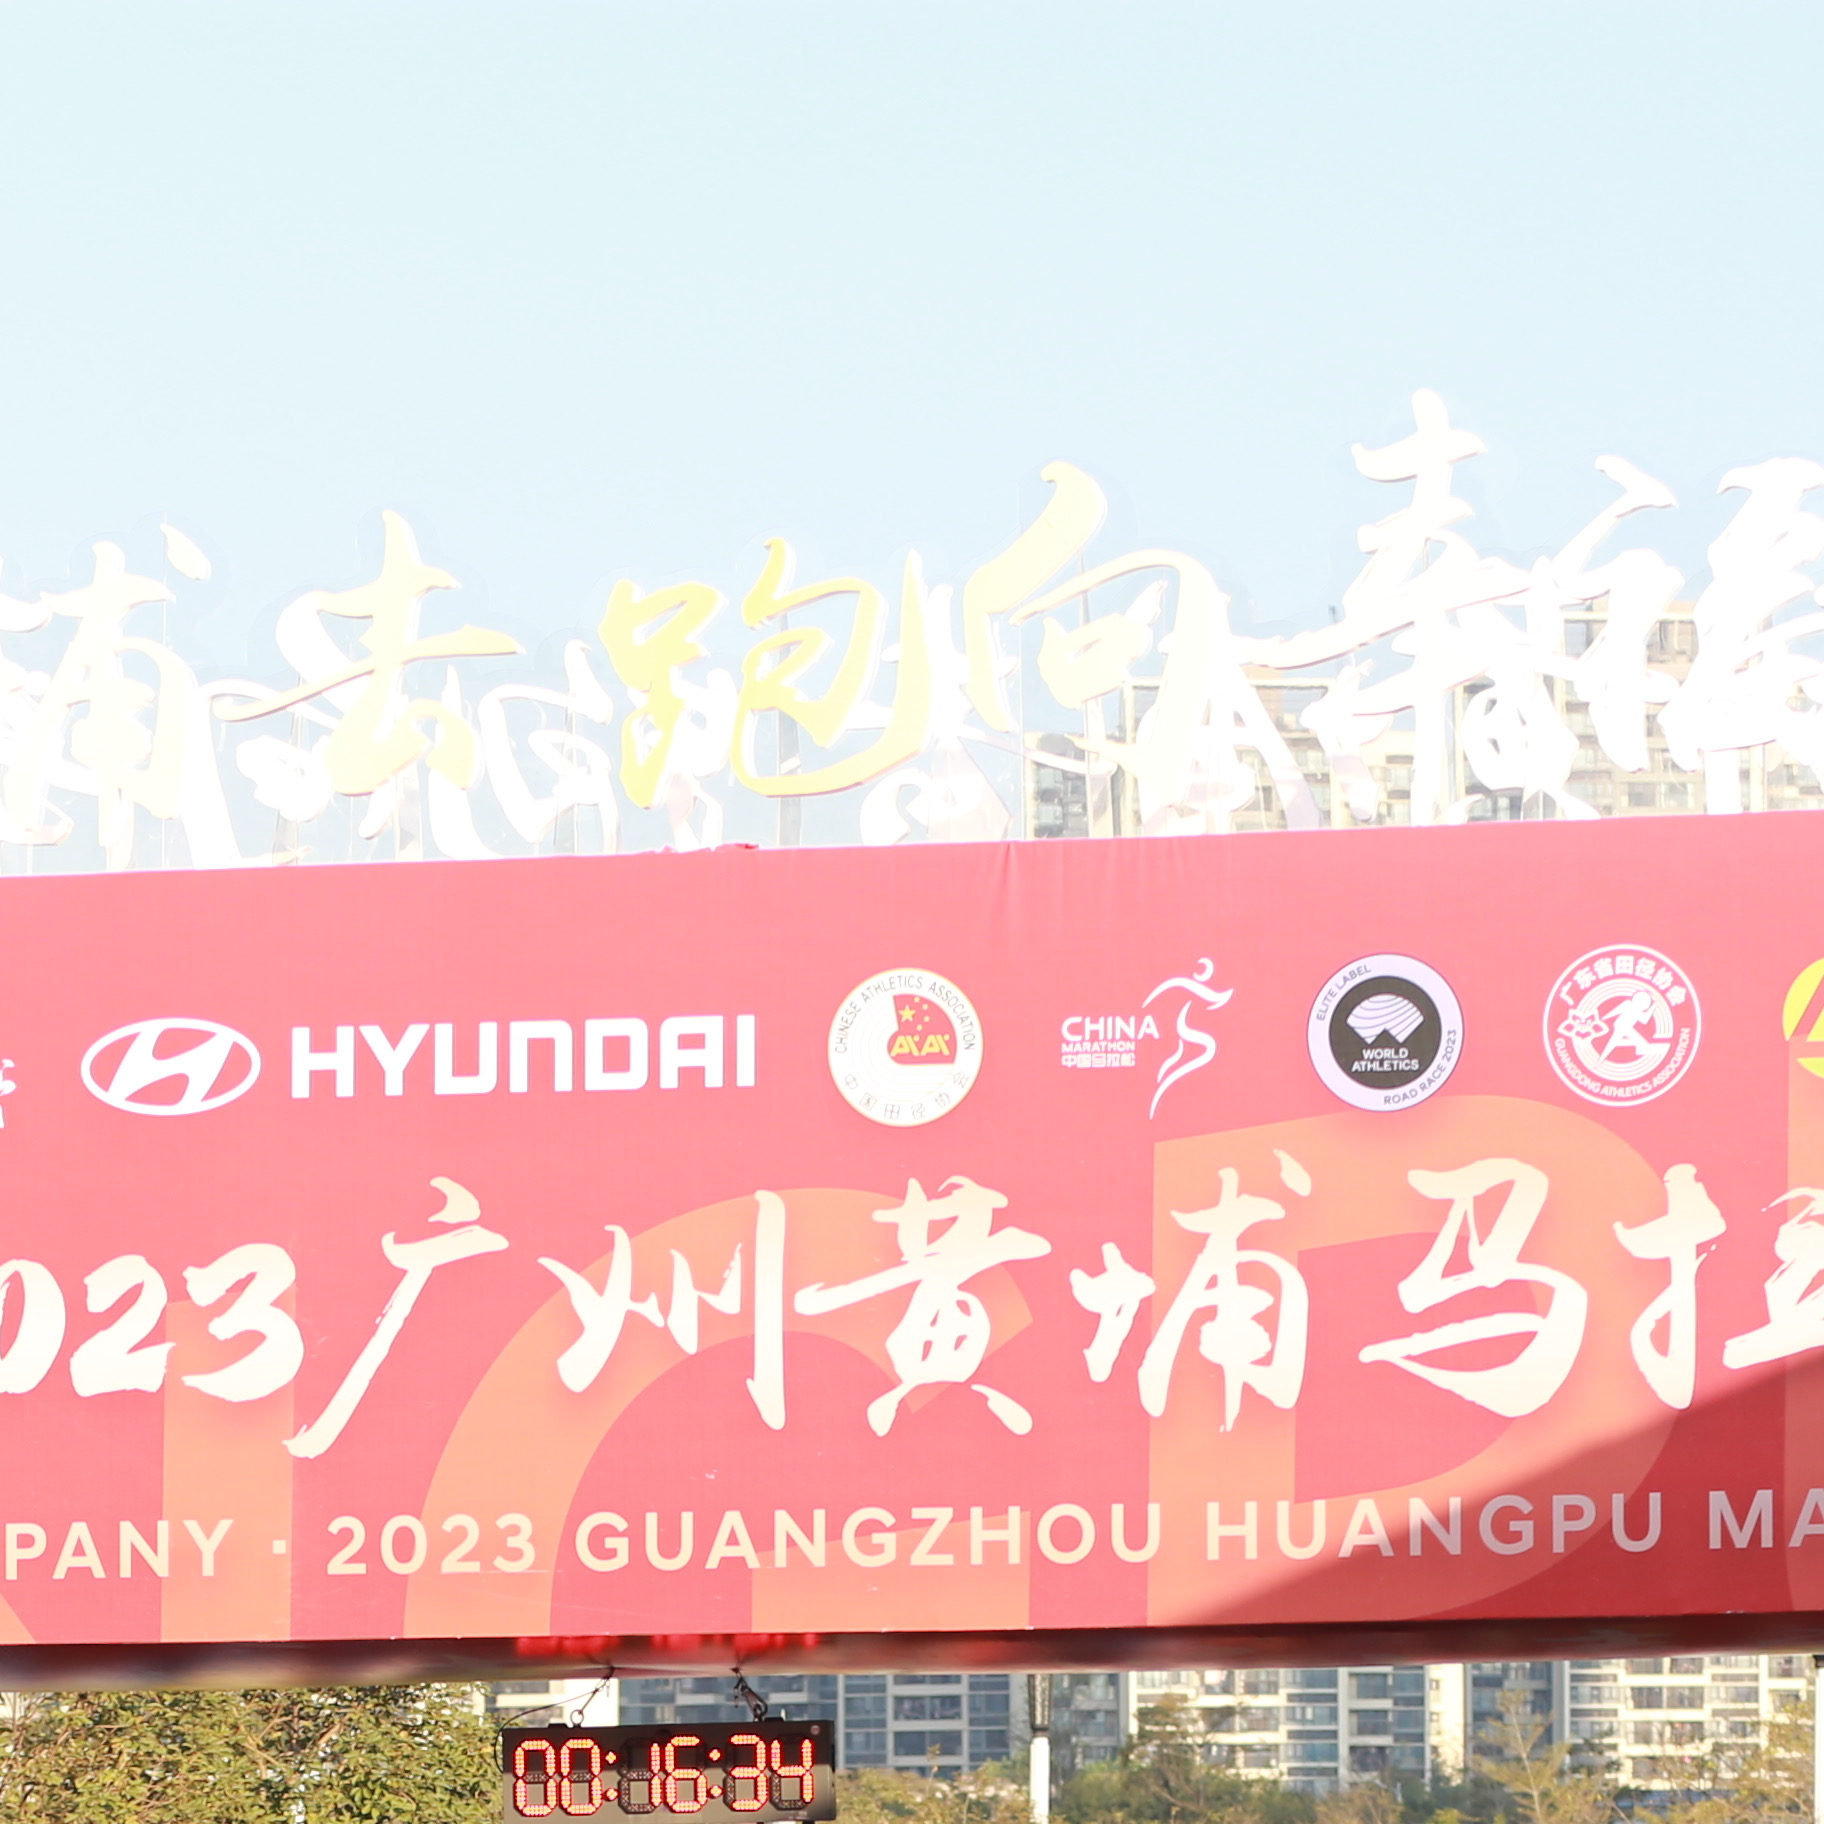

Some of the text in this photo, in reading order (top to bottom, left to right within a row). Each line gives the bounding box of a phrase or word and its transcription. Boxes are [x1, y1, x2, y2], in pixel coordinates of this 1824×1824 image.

[834, 974, 977, 1054] CHINESE ATHLETICS ASSOCIATION
[1061, 1014, 1160, 1042] CHINA
[1316, 964, 1373, 1022] ELITE LABEL
[291, 1014, 756, 1099] HYUNDAI
[1061, 1040, 1136, 1054] MARATHON
[1351, 1059, 1420, 1073] ATHLETICS
[1362, 1047, 1409, 1060] WORLD
[1383, 1028, 1457, 1105] ROAD RACE 2023
[1554, 1027, 1692, 1098] GUANGDONG ATHLETICS ASSOCIATION
[326, 1512, 537, 1576] 2023
[574, 1501, 1162, 1573] GUANGZHOU
[1206, 1490, 1664, 1562] HUANGPU
[513, 1732, 815, 1818] 00:16:34
